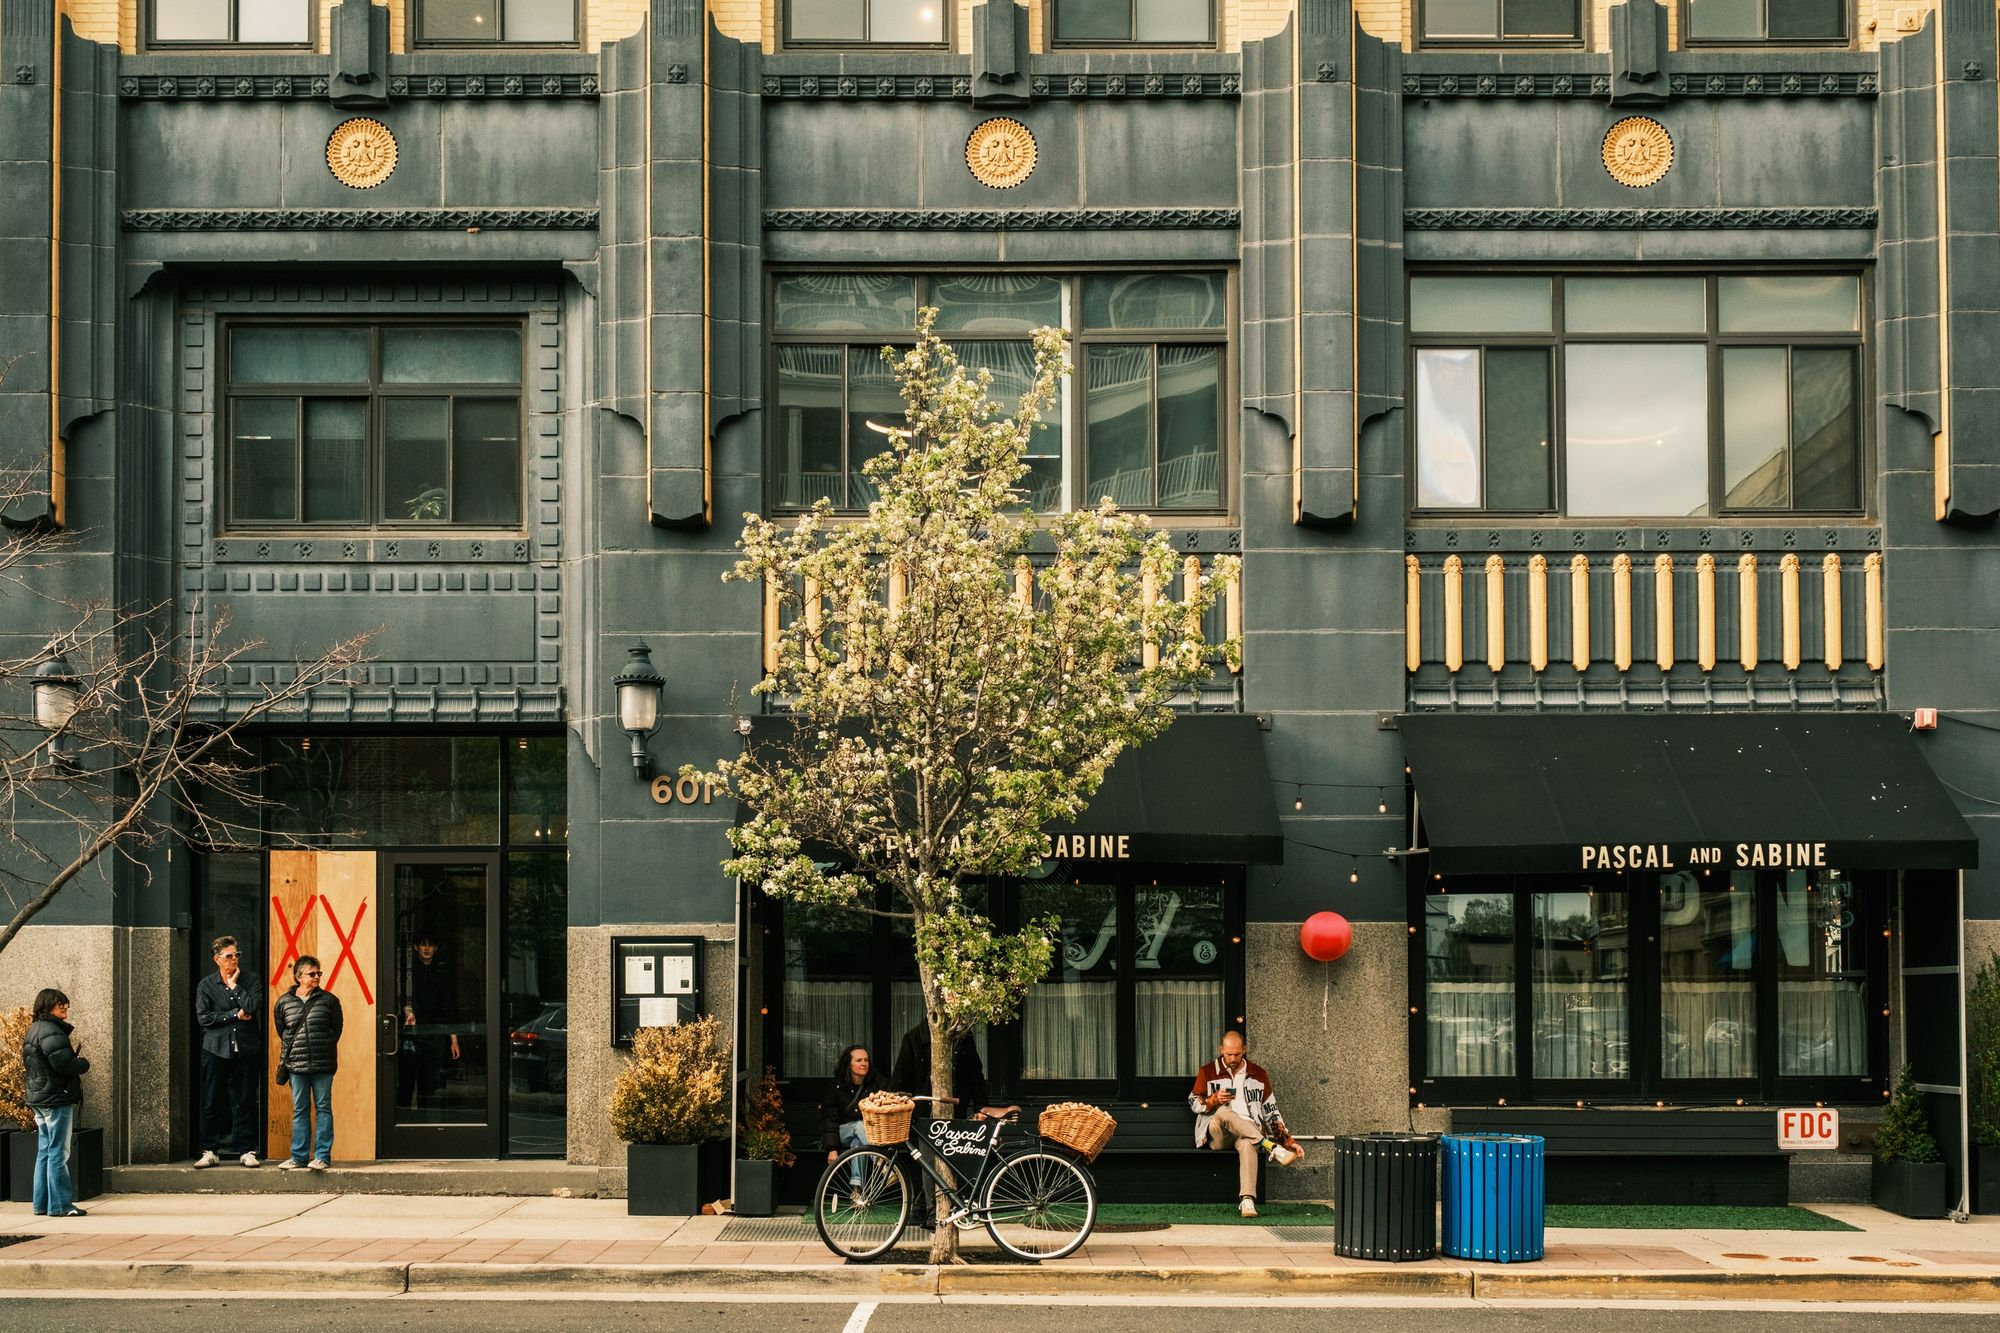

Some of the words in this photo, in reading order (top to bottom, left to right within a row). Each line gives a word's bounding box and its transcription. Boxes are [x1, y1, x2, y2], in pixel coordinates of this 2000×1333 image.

[651, 775, 711, 804] 601
[1040, 834, 1131, 859] SABINE
[1582, 845, 1674, 869] PASCAL
[1690, 848, 1722, 864] AND
[1736, 843, 1827, 867] SABINE
[928, 1120, 987, 1142] Pascal
[1783, 1112, 1832, 1139] FDC
[942, 1140, 987, 1156] Sabine
